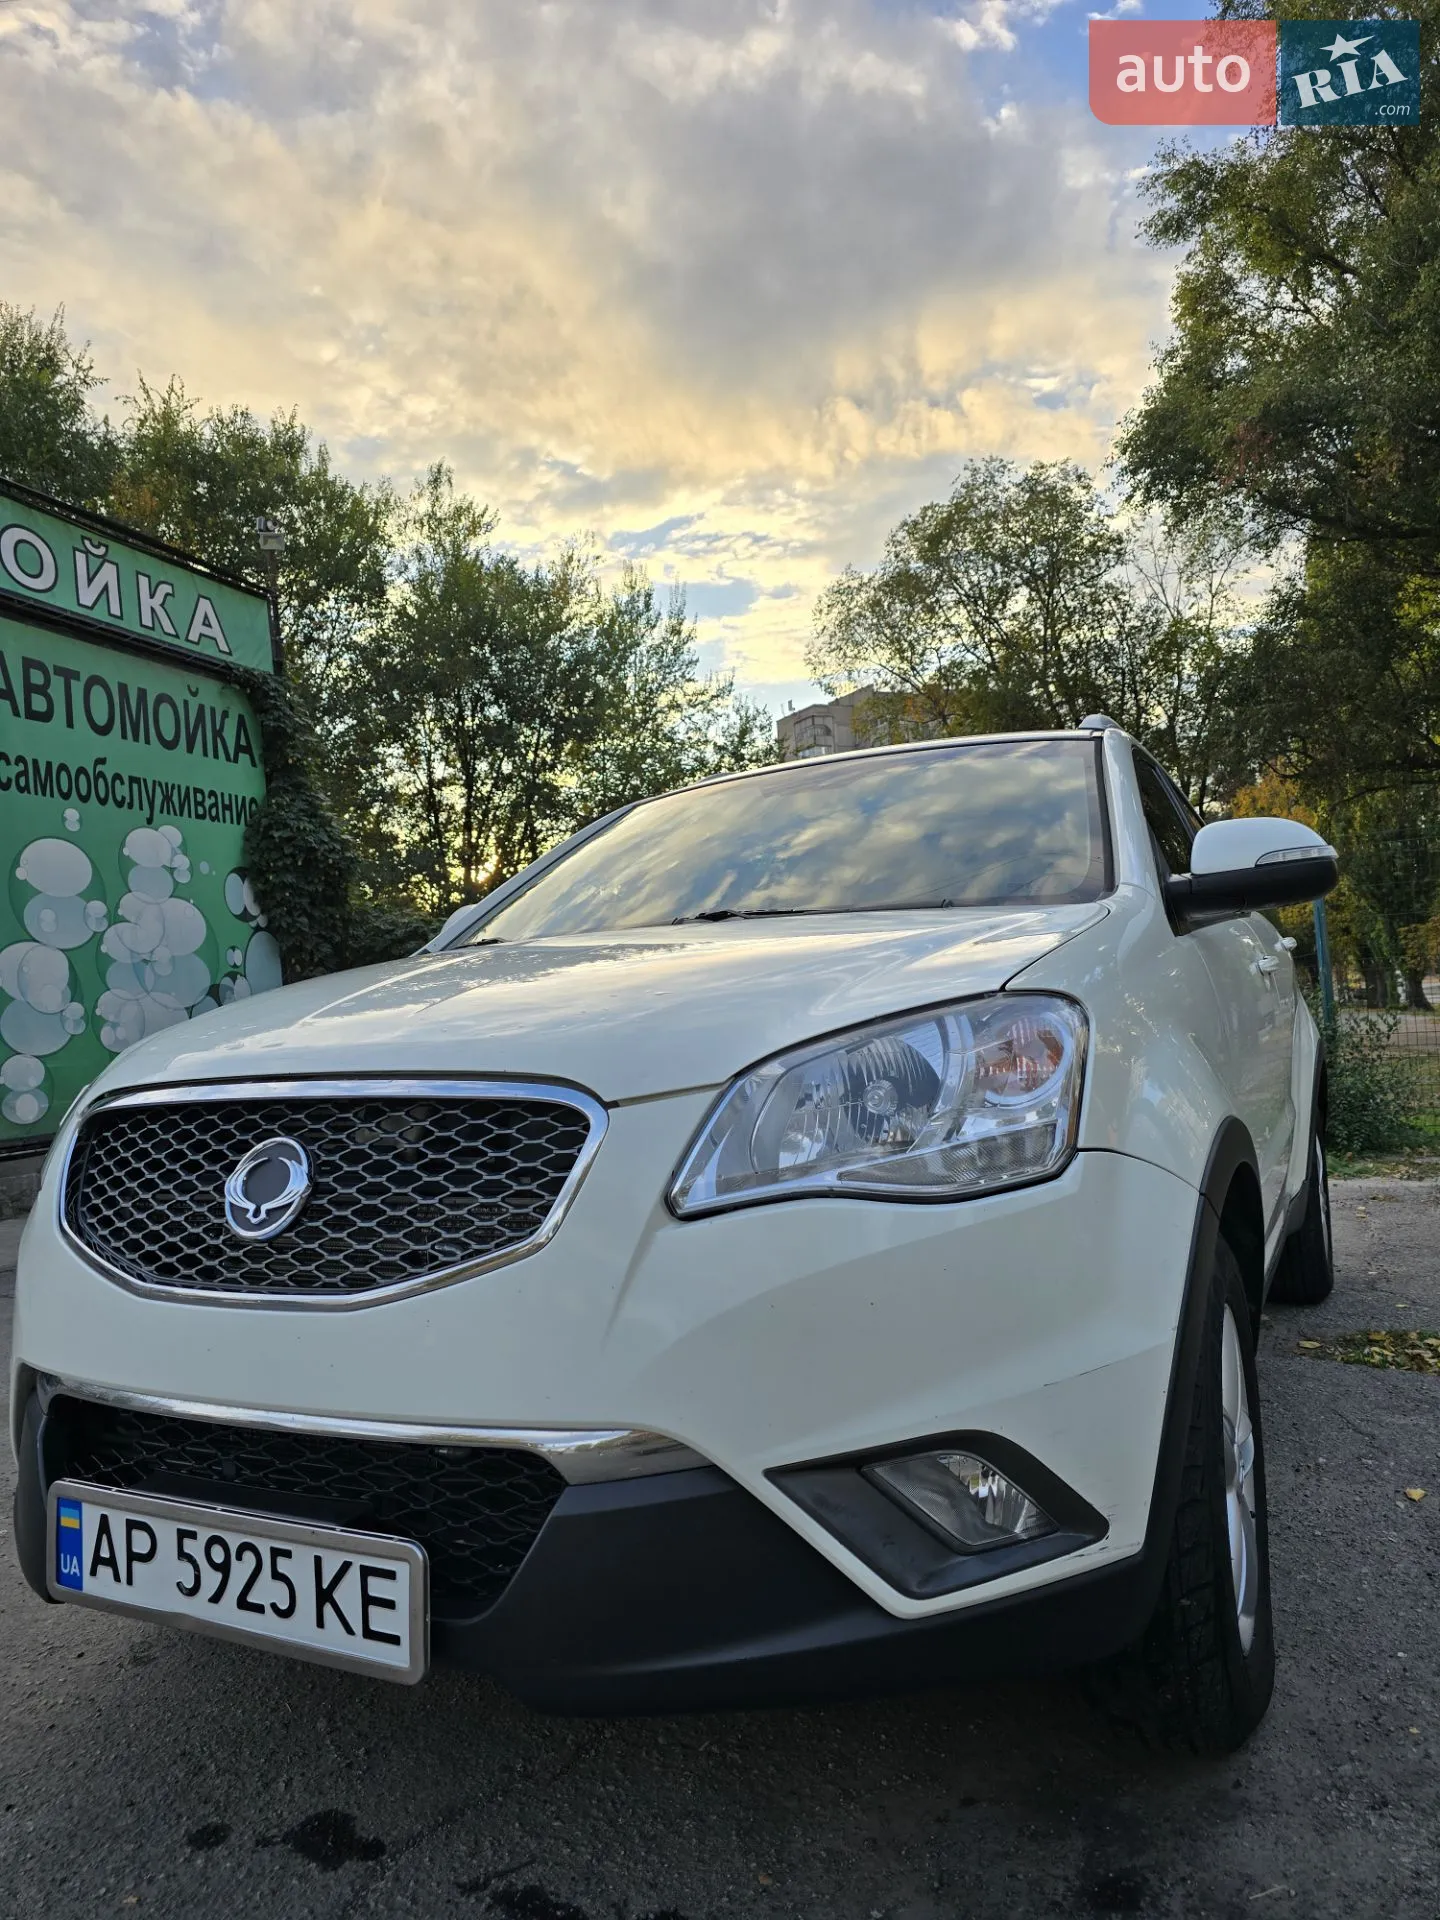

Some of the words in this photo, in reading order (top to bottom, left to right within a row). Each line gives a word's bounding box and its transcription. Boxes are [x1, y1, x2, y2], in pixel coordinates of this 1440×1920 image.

[0, 523, 232, 655] ОЙКА
[0, 651, 258, 768] АВТОМОЙКА
[61, 1552, 80, 1577] UA
[89, 1513, 158, 1586] AP
[176, 1528, 297, 1618] 5925
[314, 1554, 401, 1646] KE
